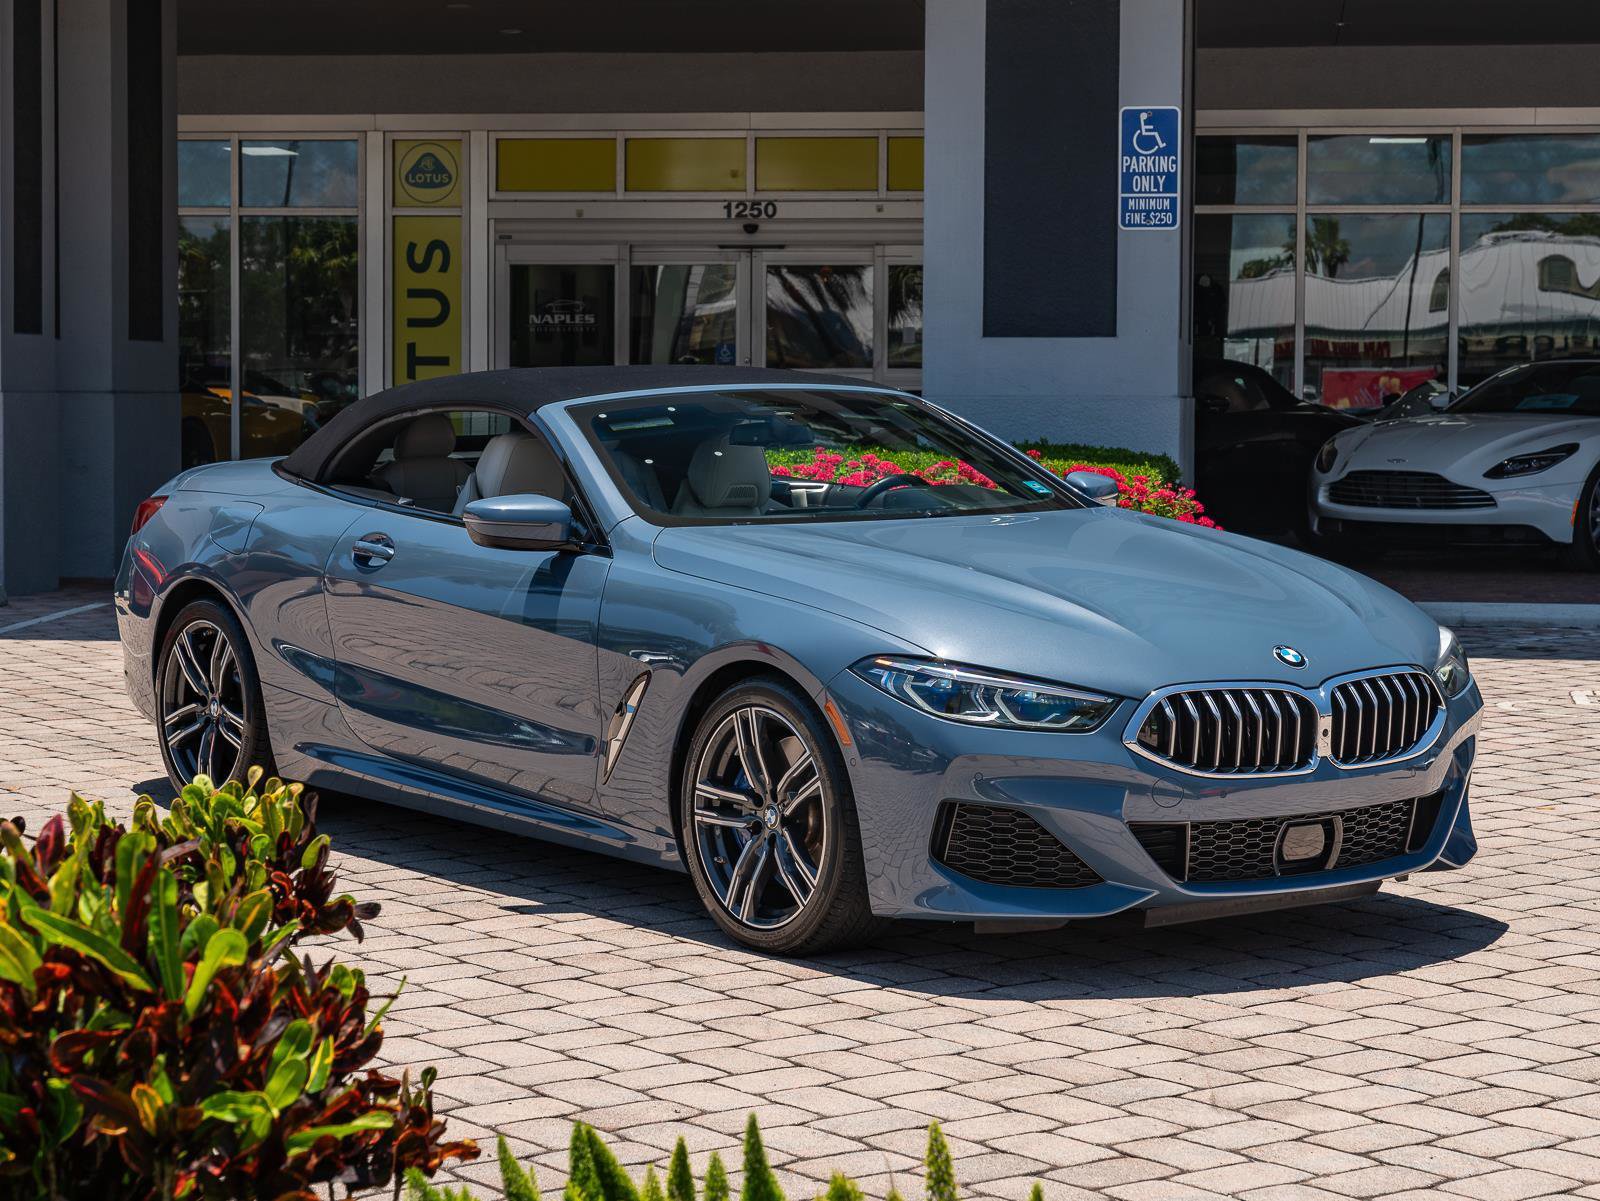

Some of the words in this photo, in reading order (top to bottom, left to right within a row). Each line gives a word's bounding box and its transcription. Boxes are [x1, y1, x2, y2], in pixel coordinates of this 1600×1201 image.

[1123, 156, 1176, 172] PARKING
[408, 173, 450, 183] LOTUS
[1133, 175, 1165, 191] ONLY
[723, 201, 777, 218] 1250
[1128, 198, 1170, 210] MINIMUM
[1125, 213, 1146, 224] FINE
[1150, 212, 1172, 225] $250
[406, 239, 451, 381] TUS
[529, 314, 596, 324] NAPLES
